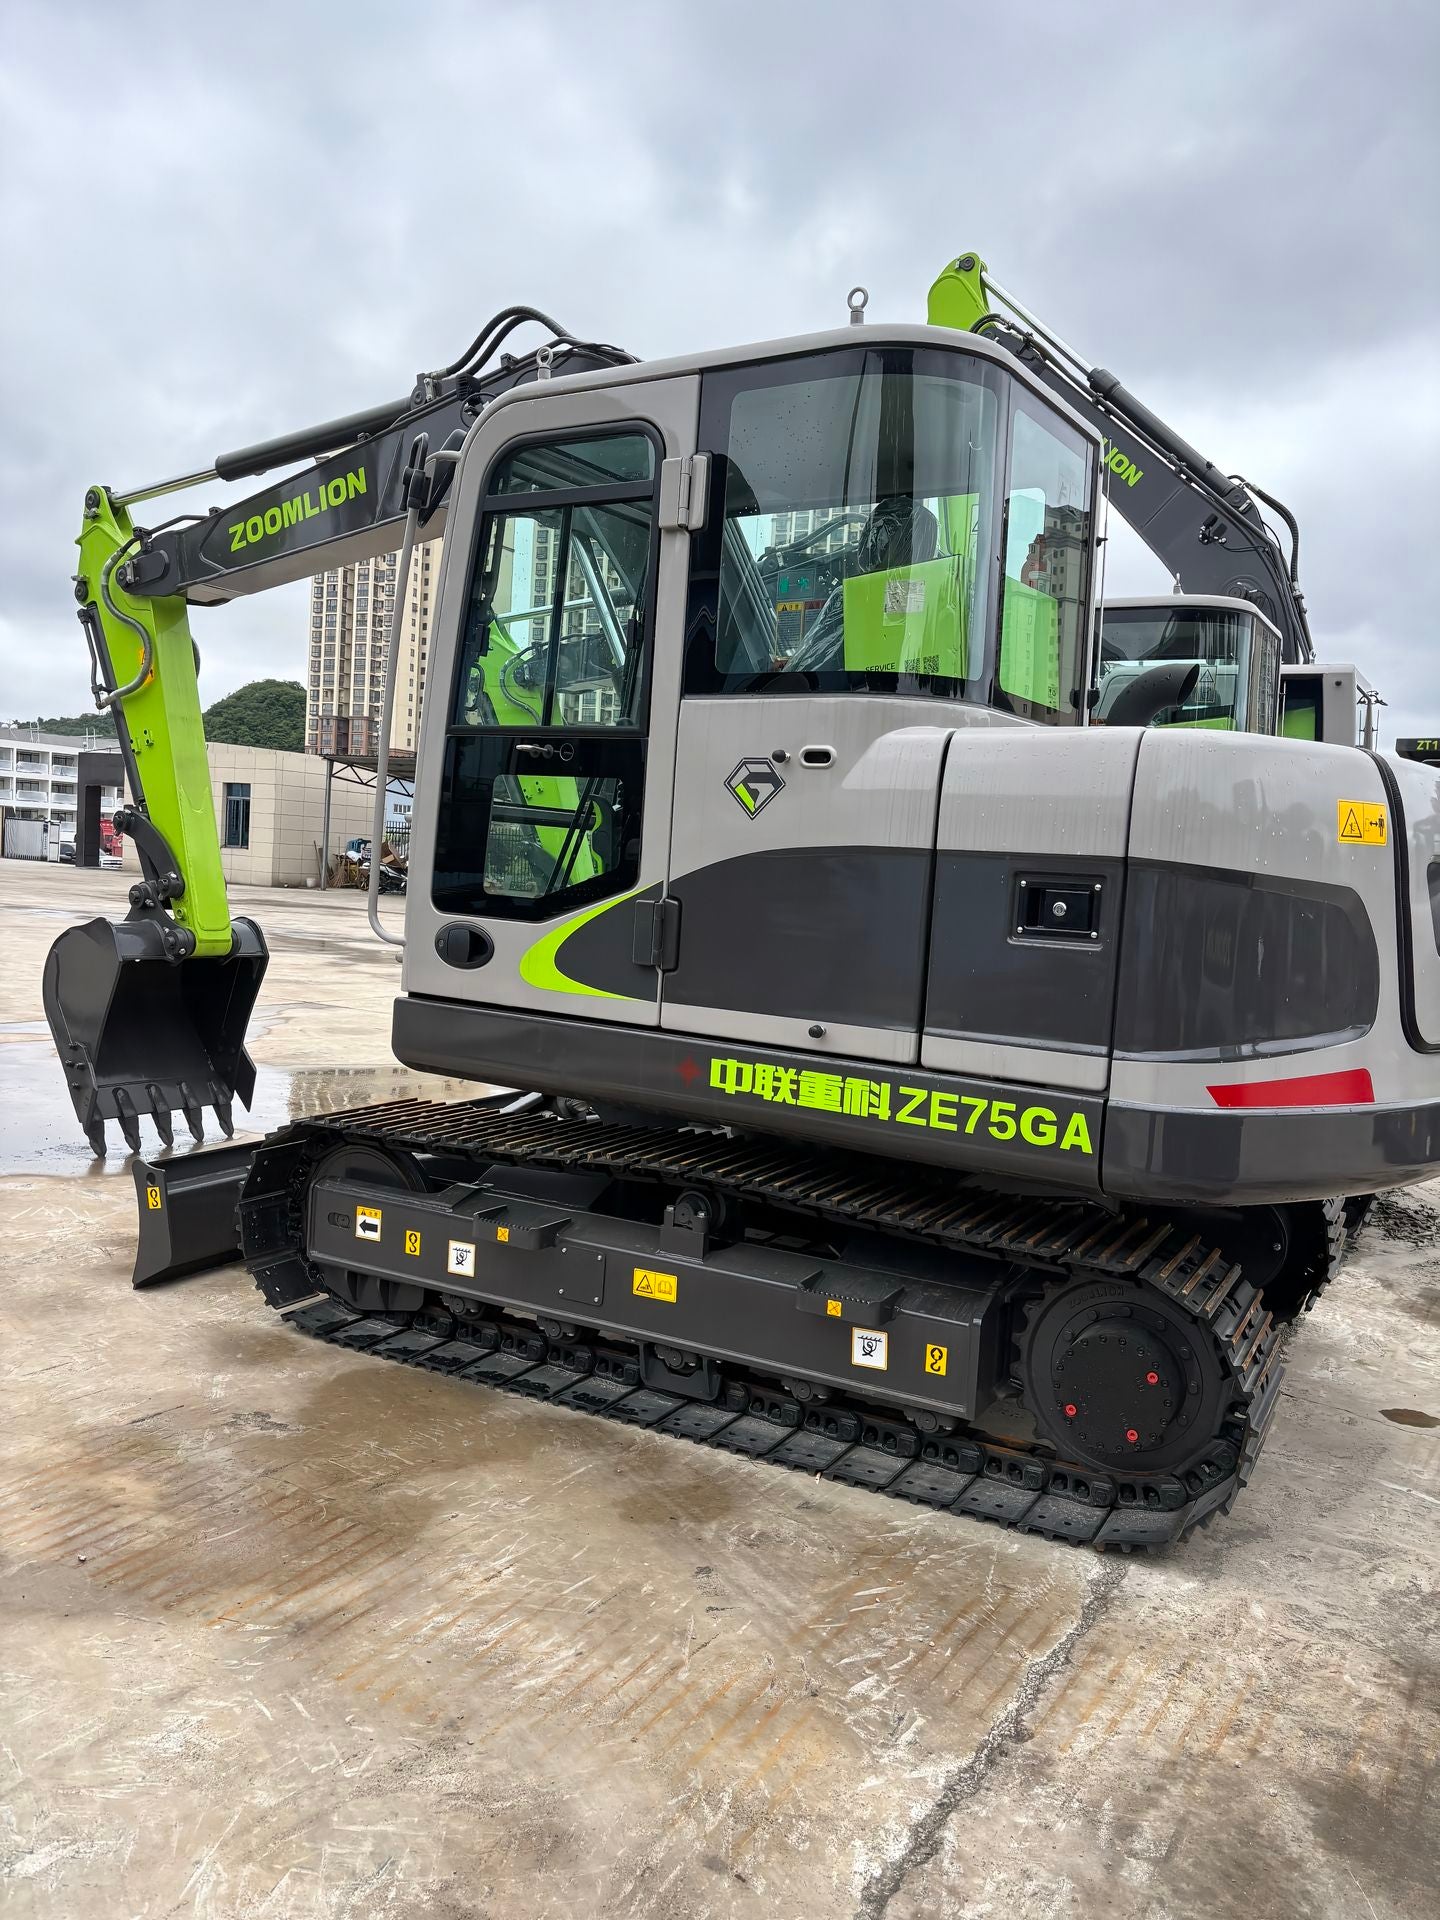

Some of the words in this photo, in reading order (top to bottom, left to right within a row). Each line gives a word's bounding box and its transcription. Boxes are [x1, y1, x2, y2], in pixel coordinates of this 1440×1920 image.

[228, 466, 367, 552] ZOOMLION
[865, 662, 896, 672] SERVICE
[1416, 740, 1438, 750] ZT1
[709, 1058, 892, 1121] 中联重科
[895, 1086, 1093, 1154] ZE75GA
